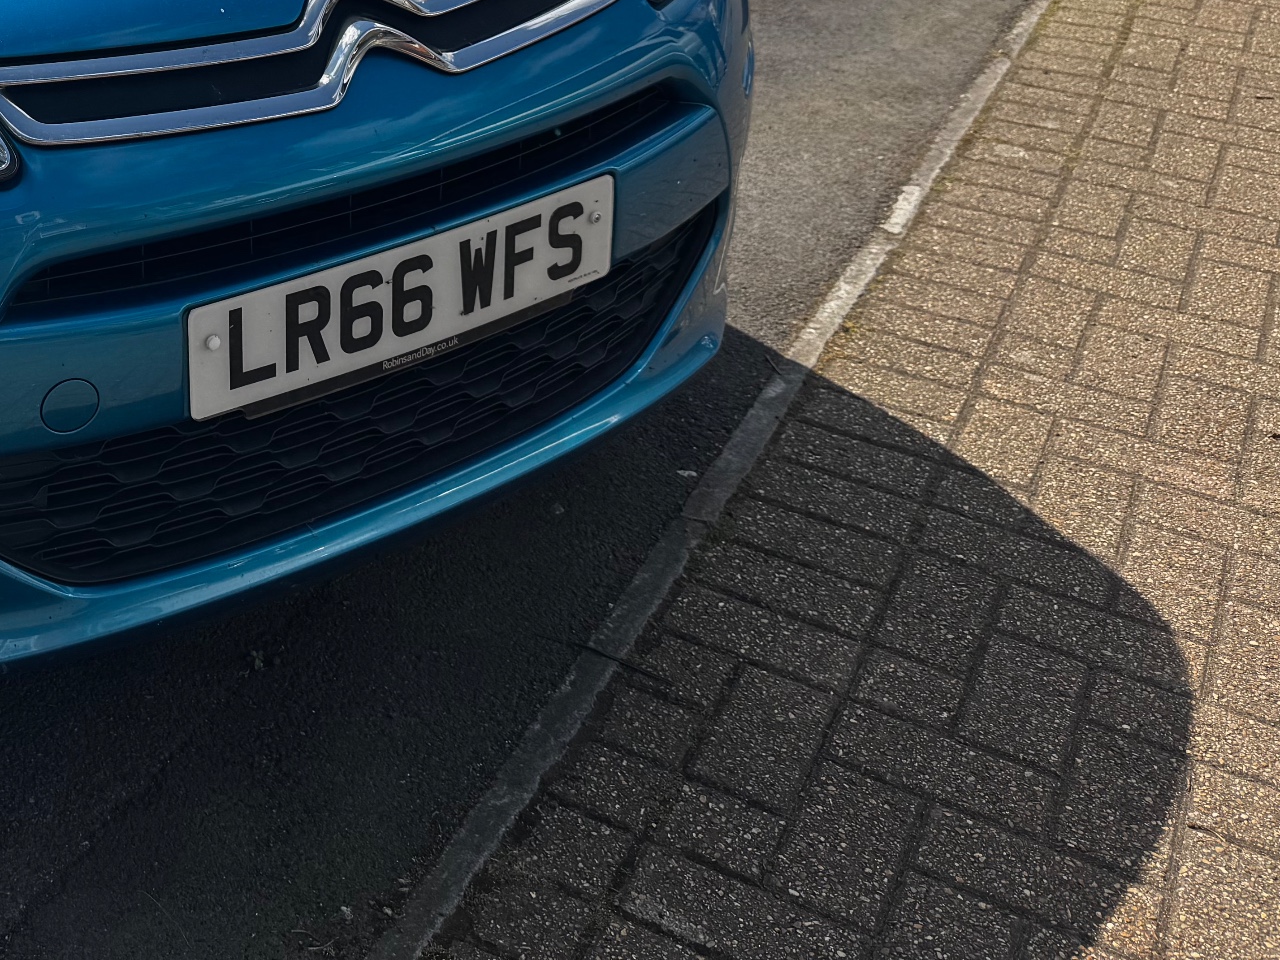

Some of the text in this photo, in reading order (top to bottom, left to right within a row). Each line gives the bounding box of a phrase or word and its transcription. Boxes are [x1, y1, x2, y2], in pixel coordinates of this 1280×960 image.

[228, 201, 585, 390] LR66 WFS
[382, 336, 459, 370] RobinsandDay.co.uk
